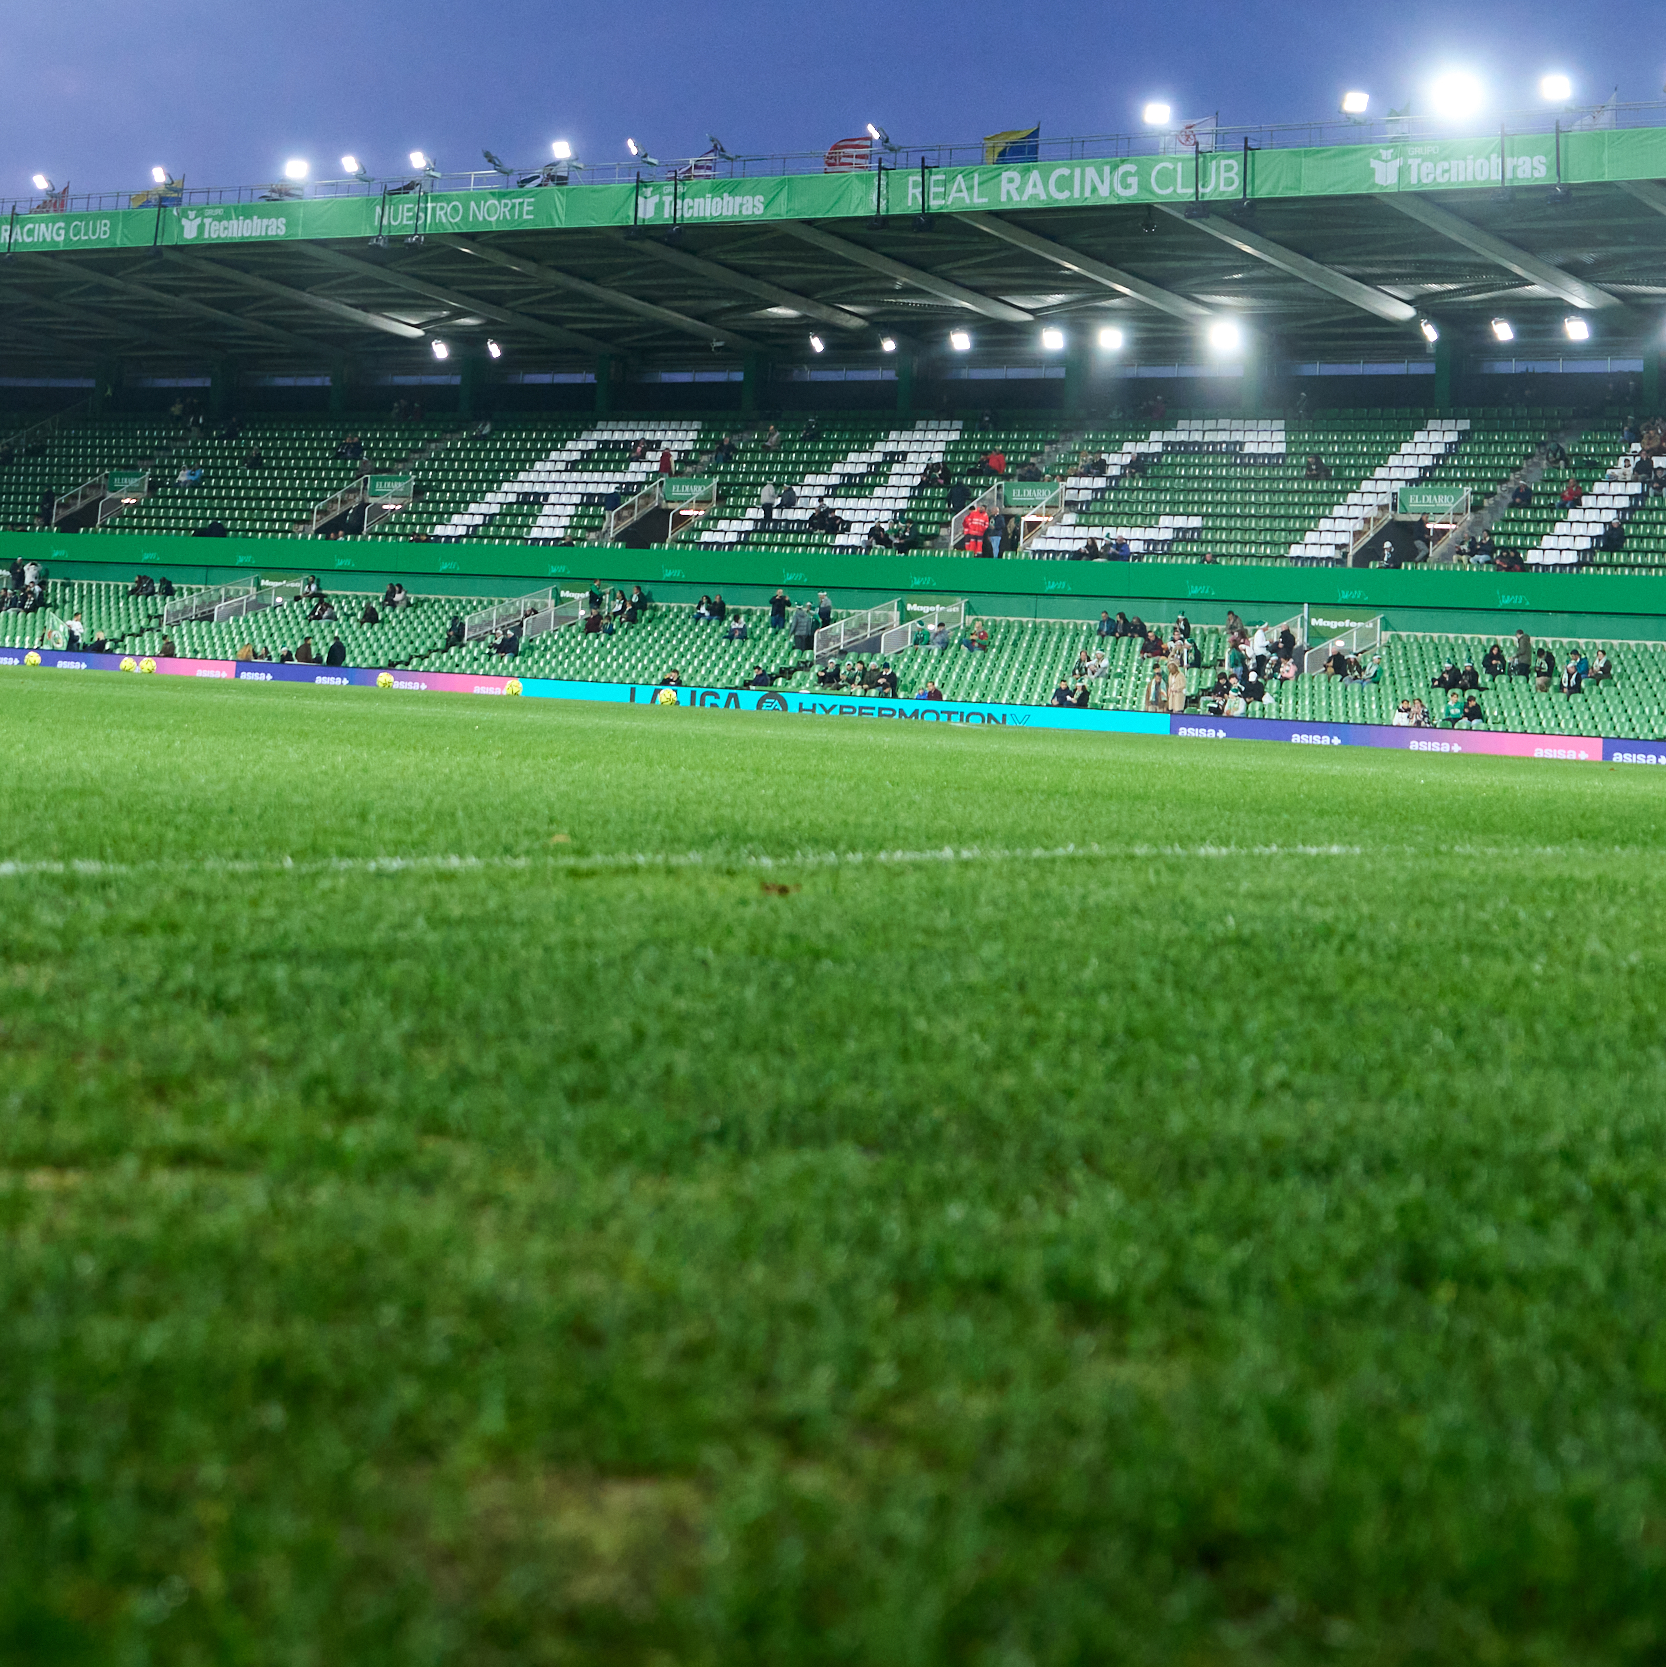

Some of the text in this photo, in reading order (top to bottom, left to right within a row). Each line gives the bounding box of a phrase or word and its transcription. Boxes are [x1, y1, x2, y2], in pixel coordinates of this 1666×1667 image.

[1408, 146, 1439, 155] GRUPO
[1408, 154, 1547, 185] Tecniobras
[908, 175, 988, 206] REAL
[1000, 164, 1138, 201] RACING
[1150, 159, 1240, 195] CLUB
[375, 198, 535, 226] NUESTRO NORTE
[662, 193, 764, 217] Tecniobras
[0, 221, 65, 243] RACING
[70, 219, 110, 240] CLUB
[203, 216, 286, 238] Tecniobras
[672, 484, 681, 492] EL
[1013, 489, 1051, 497] EL DIARIO
[1409, 494, 1455, 504] EL DIARIO
[630, 687, 741, 709] LAIGA
[763, 698, 783, 711] EA
[798, 702, 1007, 725] HYPERMOTION
